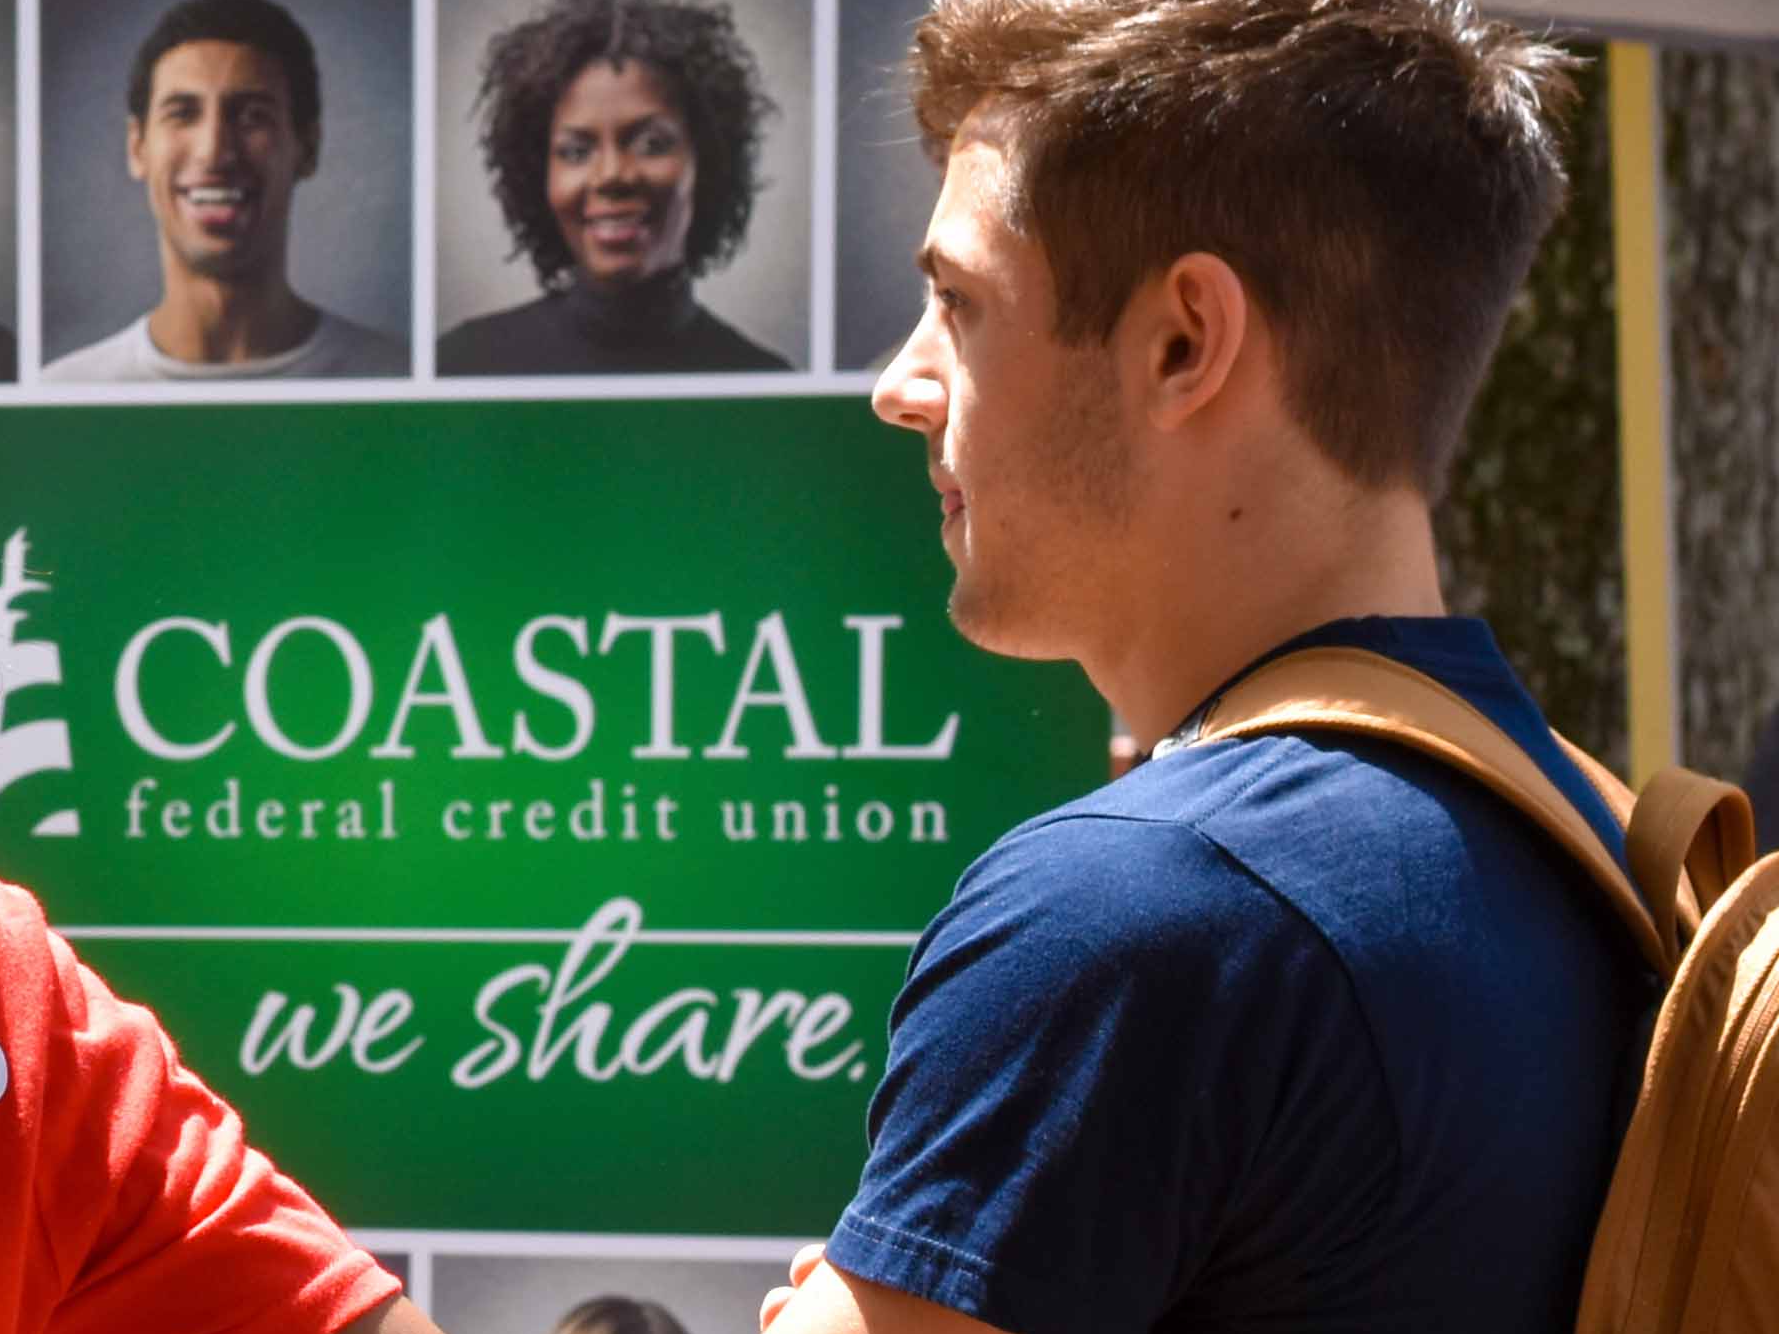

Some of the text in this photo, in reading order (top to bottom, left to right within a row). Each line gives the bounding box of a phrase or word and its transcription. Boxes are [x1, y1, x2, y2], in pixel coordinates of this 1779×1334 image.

[114, 612, 960, 761] COASTAL
[126, 777, 947, 842] federal credit union
[240, 897, 867, 1088] we share.
